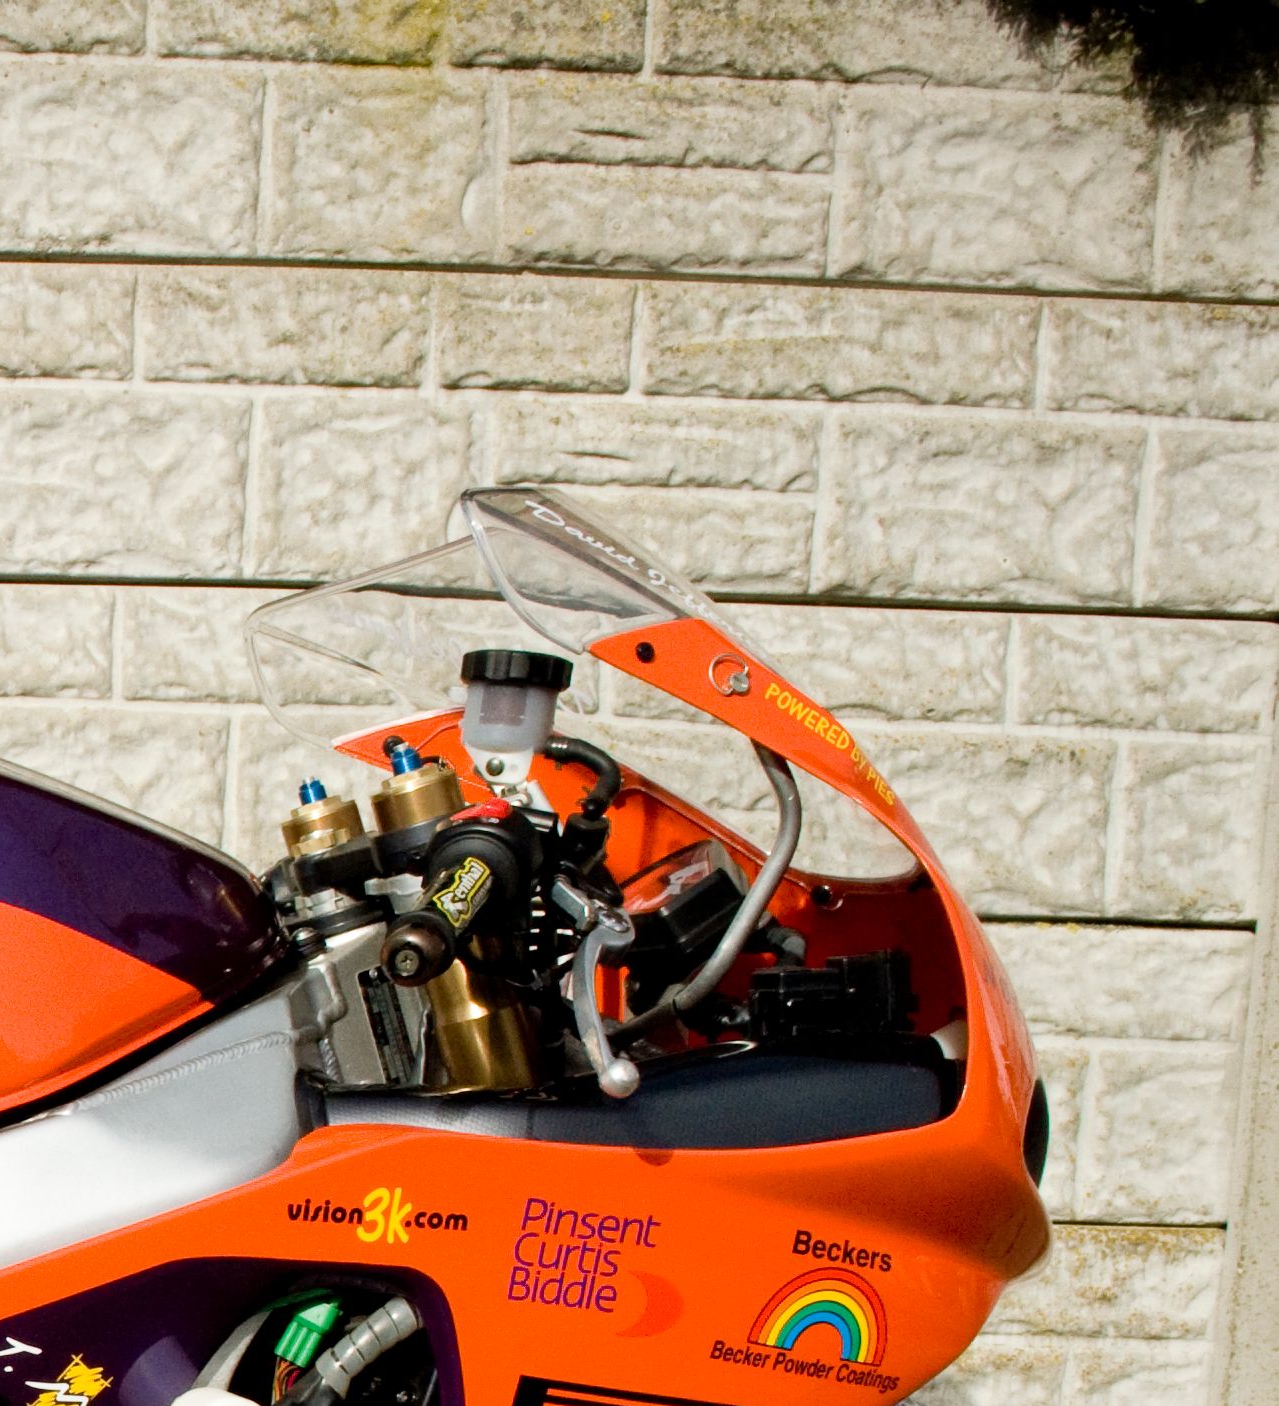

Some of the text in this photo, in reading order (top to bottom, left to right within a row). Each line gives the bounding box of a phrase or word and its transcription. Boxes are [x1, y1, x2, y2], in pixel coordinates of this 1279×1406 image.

[764, 682, 850, 750] POWERED
[866, 768, 896, 806] PIES
[520, 1197, 663, 1248] Pinsent
[513, 1231, 622, 1278] Curtis
[791, 1228, 893, 1273] Beckers
[507, 1265, 619, 1314] Biddle
[709, 1339, 901, 1395] Becker Powder Coatings
